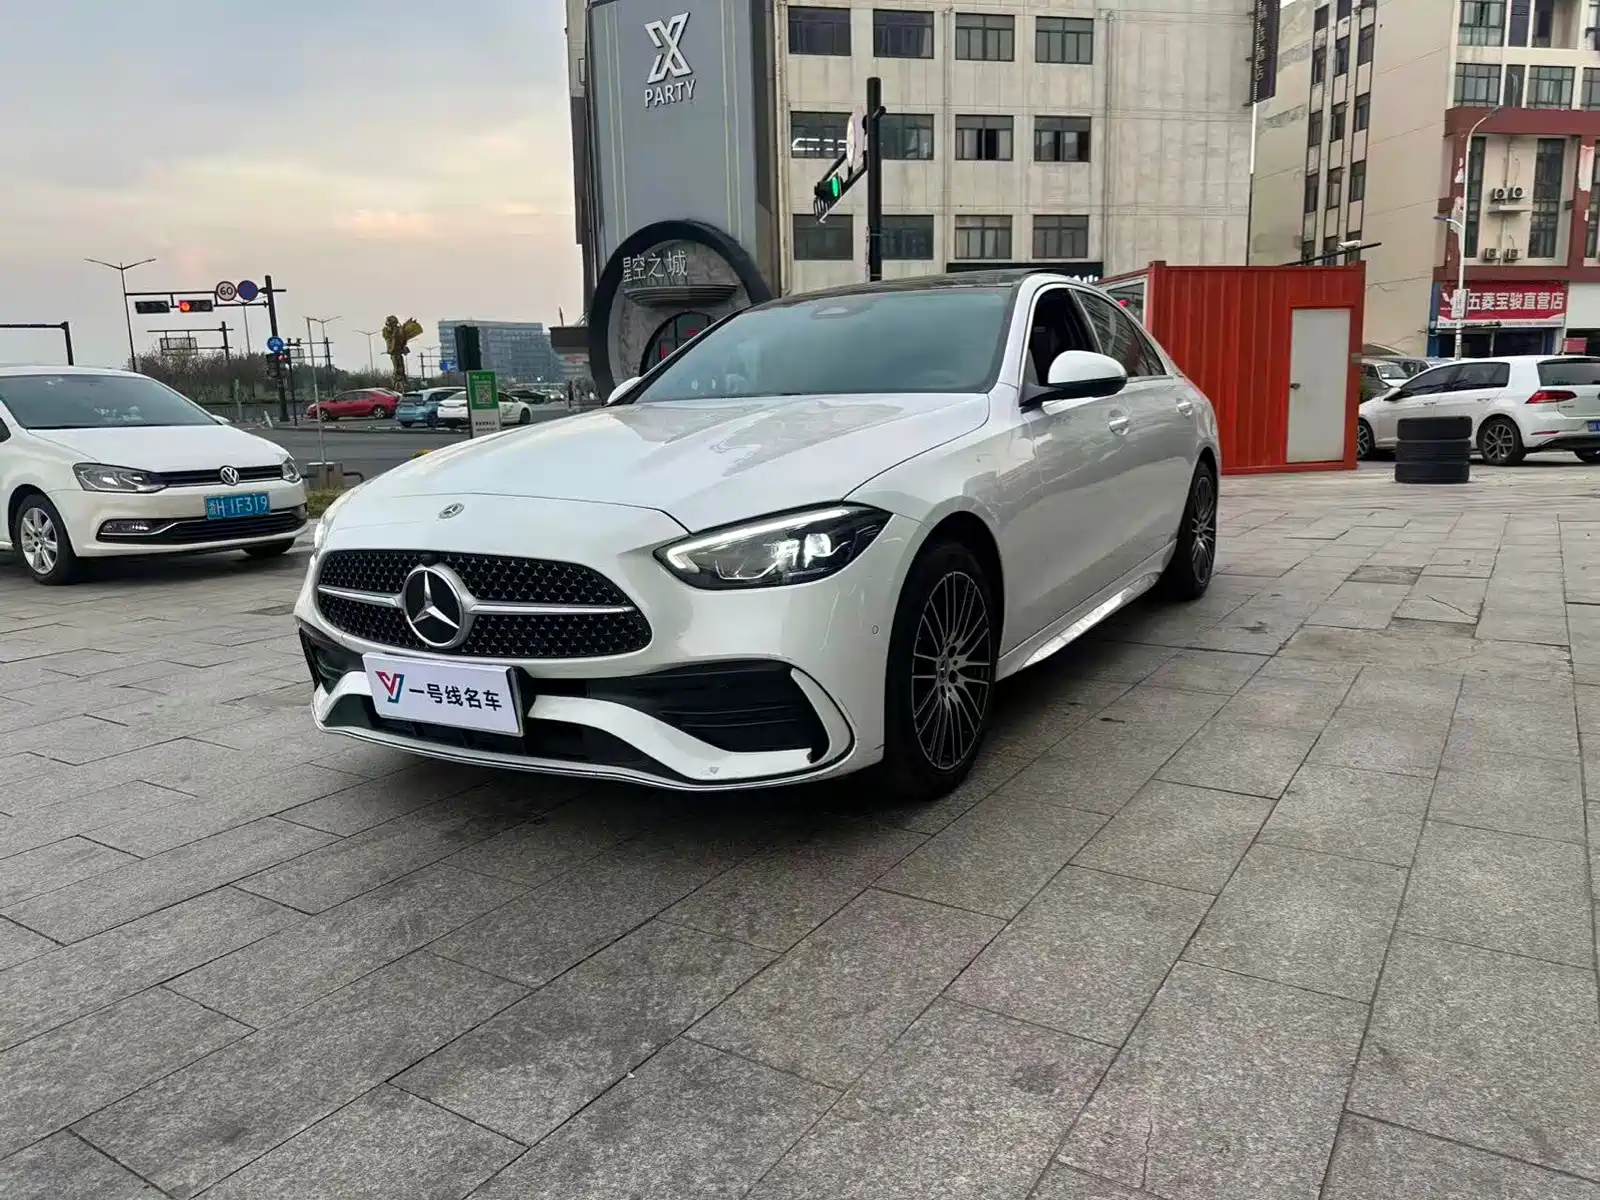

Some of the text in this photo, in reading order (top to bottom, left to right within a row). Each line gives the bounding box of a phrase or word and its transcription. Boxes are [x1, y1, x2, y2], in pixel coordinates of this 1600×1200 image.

[644, 79, 696, 107] PARTY
[623, 250, 688, 282] 星空之城
[220, 286, 233, 295] 60
[1467, 292, 1564, 310] 五菱宝骏直营店
[408, 683, 502, 711] 一号线名车
